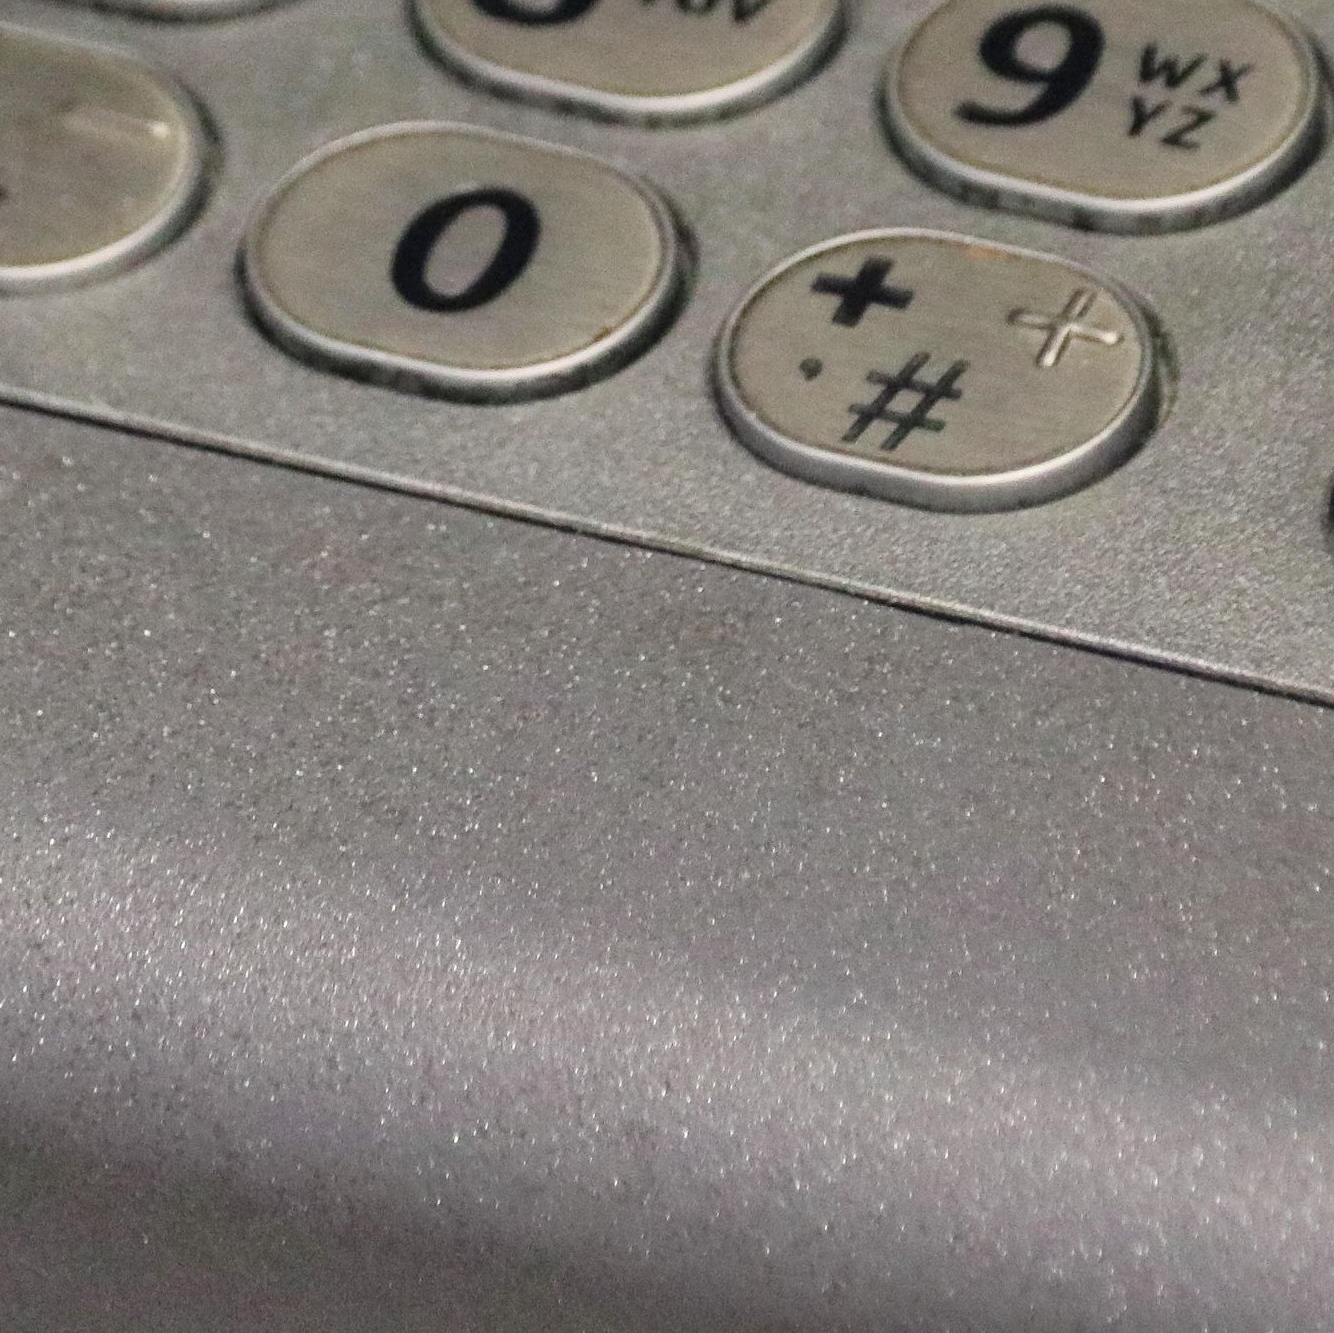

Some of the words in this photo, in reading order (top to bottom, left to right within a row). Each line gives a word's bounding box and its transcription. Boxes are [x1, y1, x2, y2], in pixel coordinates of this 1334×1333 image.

[953, 3, 1107, 128] 9
[1135, 42, 1255, 106] WX
[1123, 94, 1217, 152] YZ
[389, 184, 543, 314] 0
